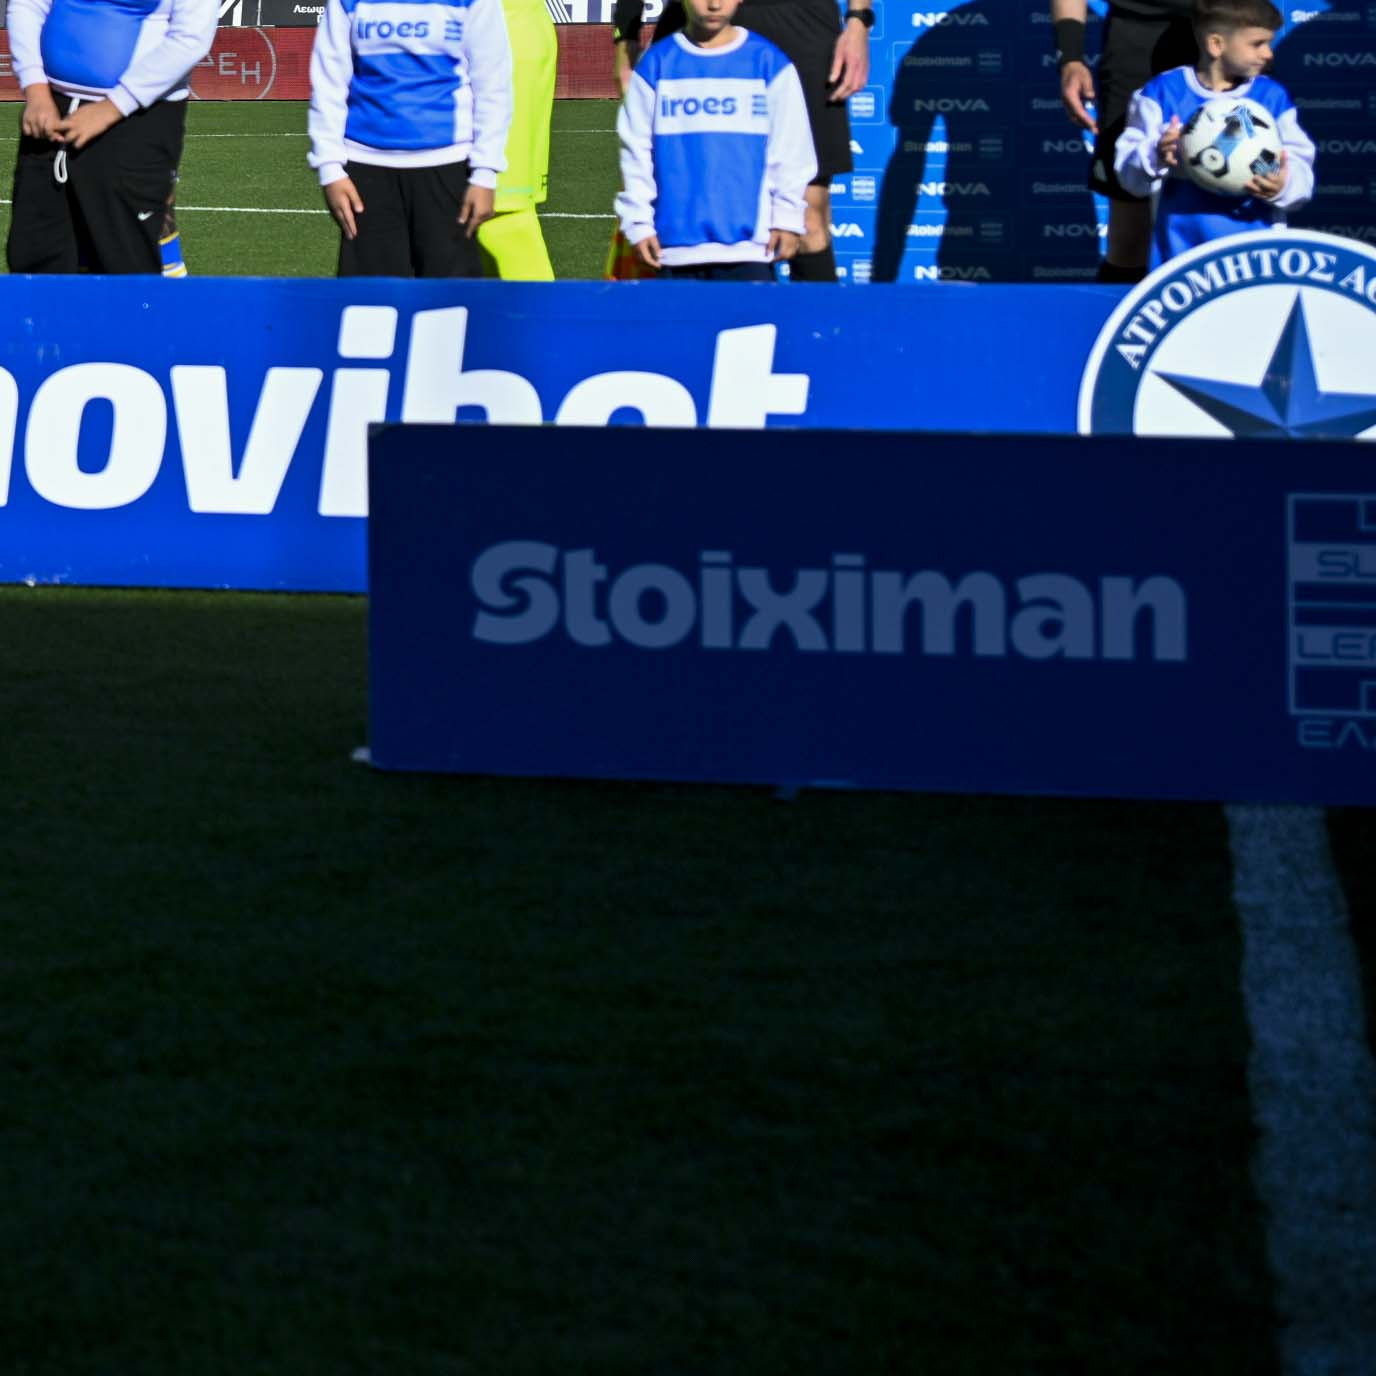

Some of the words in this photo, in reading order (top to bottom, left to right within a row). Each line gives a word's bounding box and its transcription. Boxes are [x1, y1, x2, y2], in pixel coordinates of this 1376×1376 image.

[912, 11, 989, 27] NOVA
[662, 93, 737, 119] iroes
[1115, 248, 1337, 370] ΑΤΡΟΜΗΤΟΣ
[470, 539, 1188, 662] Stoiximan
